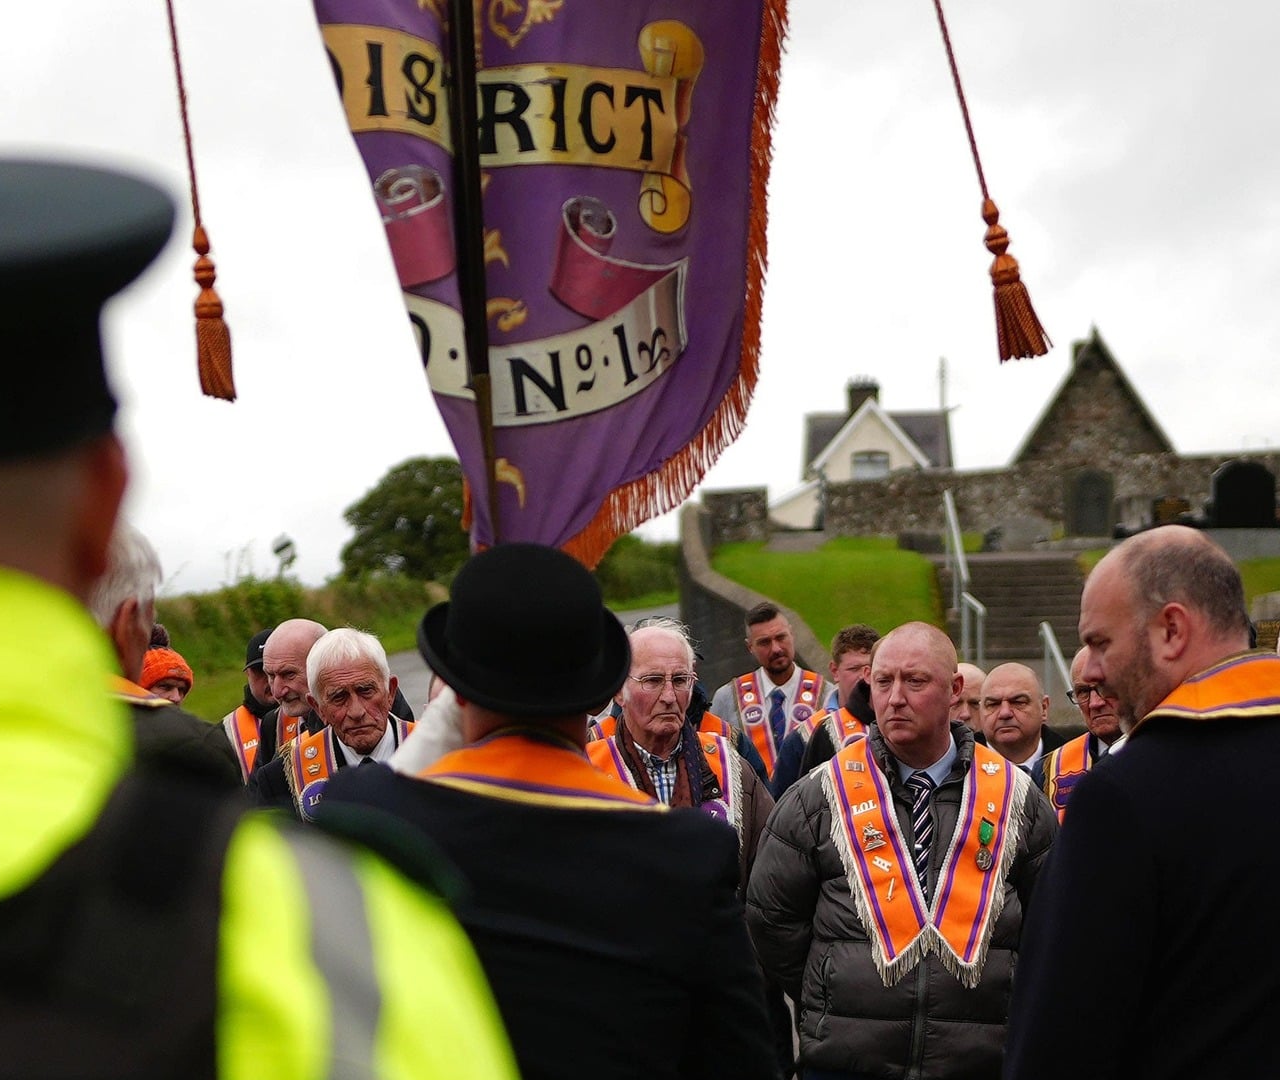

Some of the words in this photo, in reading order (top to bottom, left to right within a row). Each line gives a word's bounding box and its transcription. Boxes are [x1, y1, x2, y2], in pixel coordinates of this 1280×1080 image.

[326, 38, 665, 161] ISRICT
[243, 739, 259, 751] LOL
[309, 794, 323, 806] LO
[851, 799, 877, 816] LOL
[987, 801, 996, 813] 9
